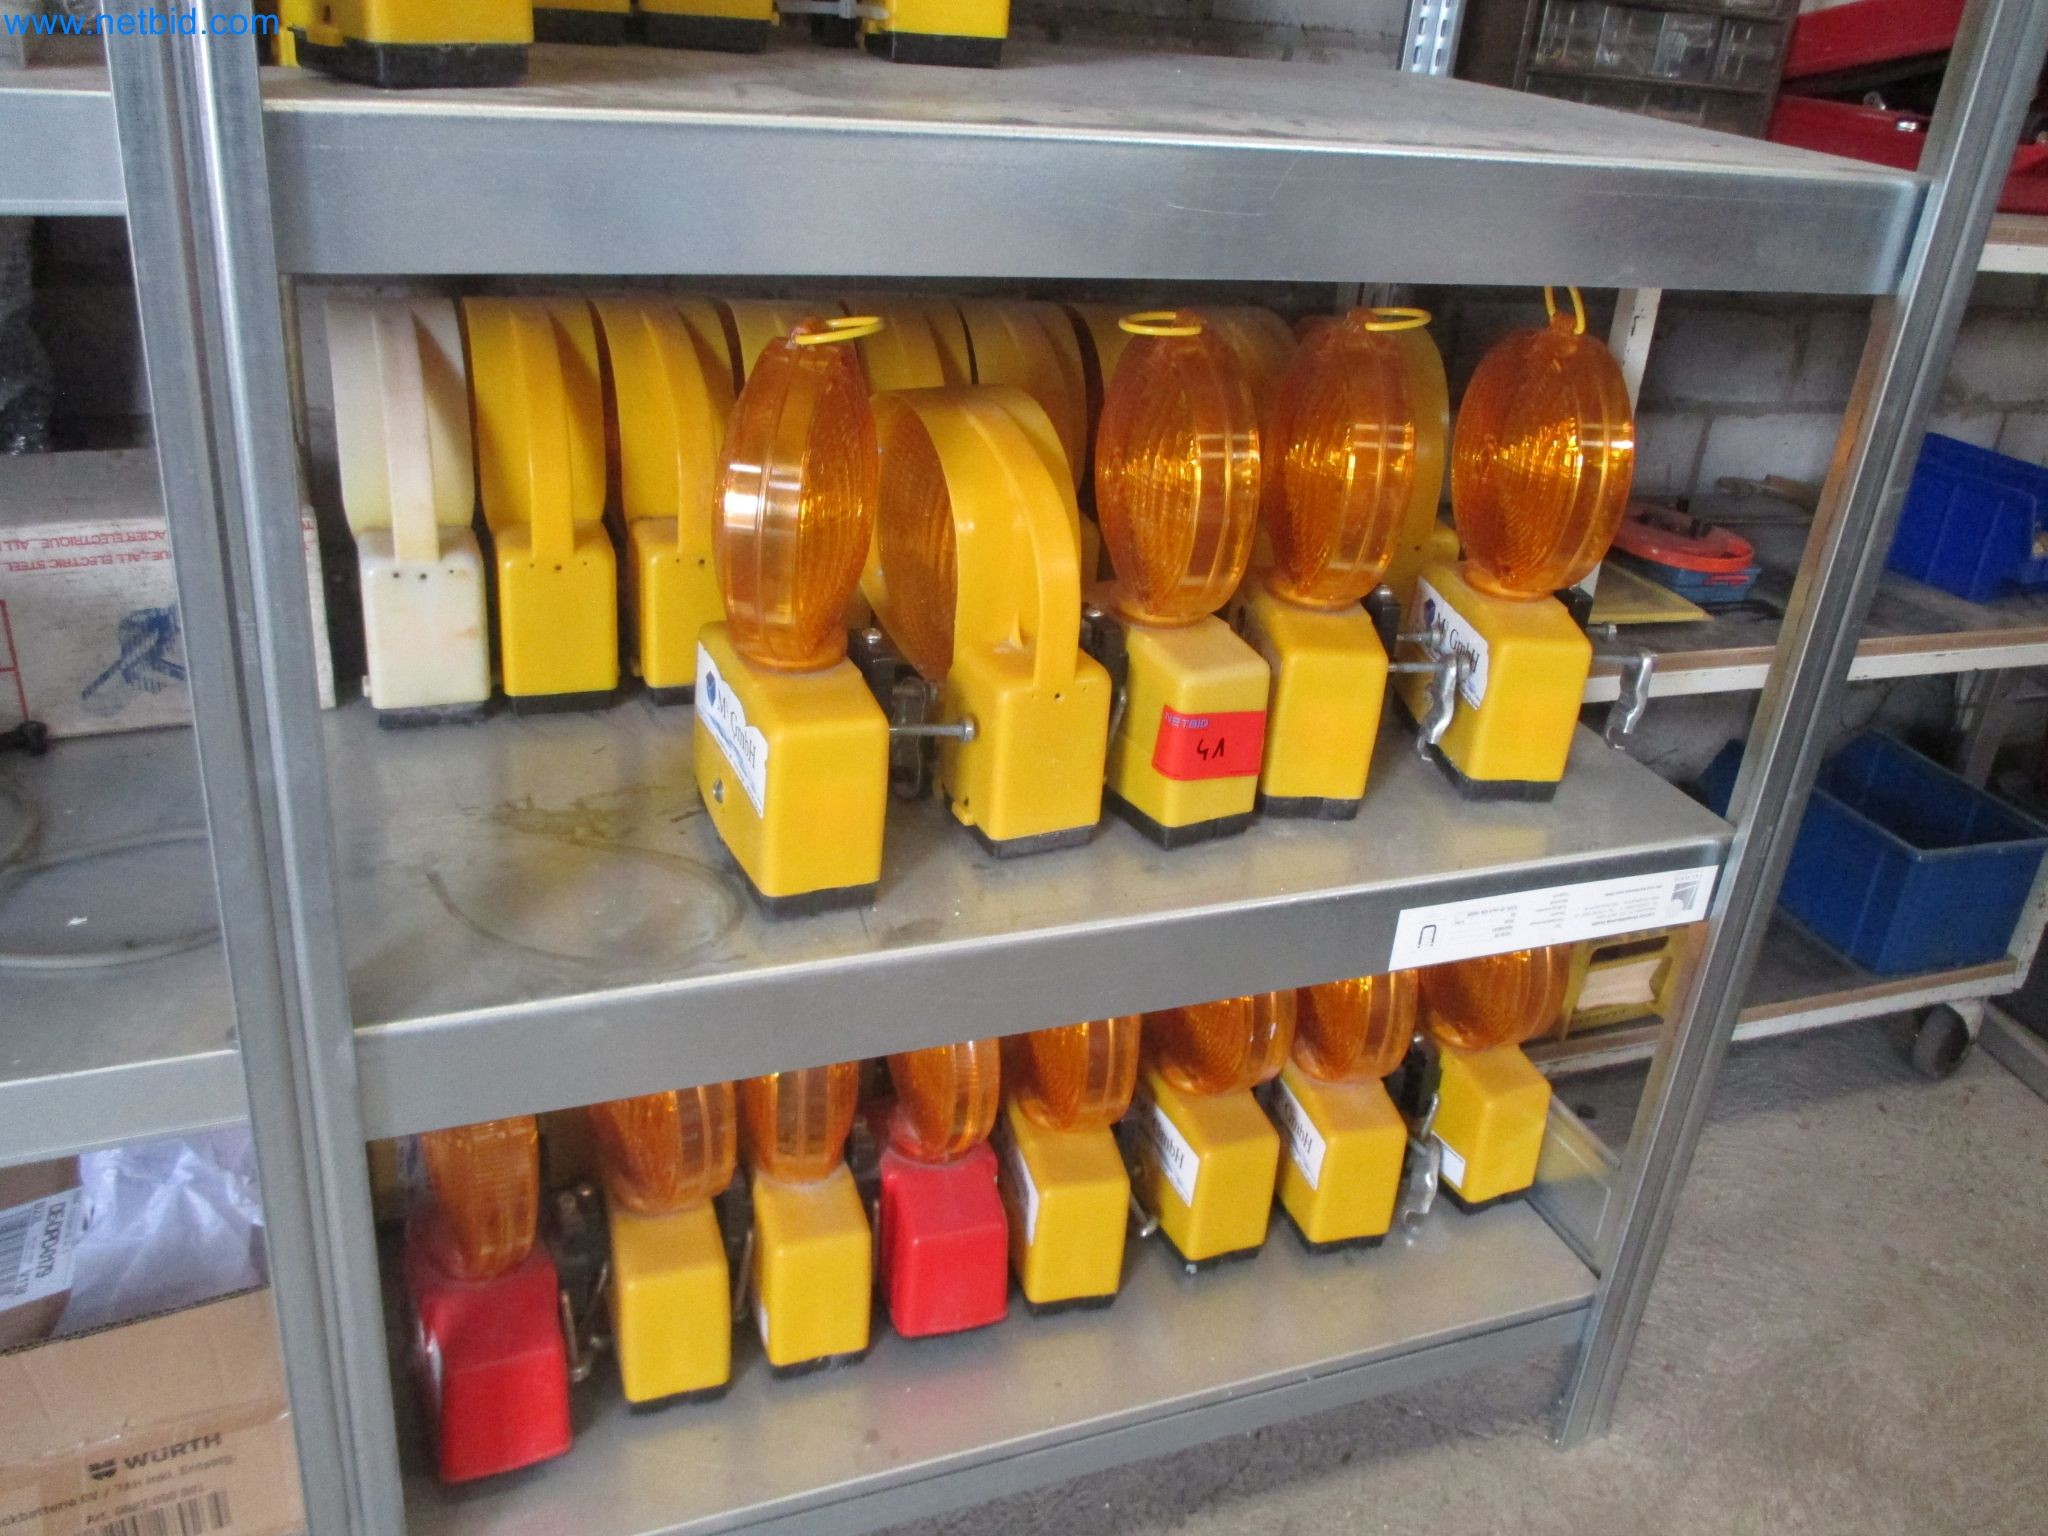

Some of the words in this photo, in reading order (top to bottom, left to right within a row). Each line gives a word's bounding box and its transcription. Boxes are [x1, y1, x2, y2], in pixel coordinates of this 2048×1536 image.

[126, 530, 166, 544] ACIER
[48, 554, 113, 570] ELECTRIC
[1165, 711, 1210, 729] NETBID
[730, 711, 757, 769] GmbH
[1196, 737, 1225, 761] 41
[124, 1432, 223, 1470] WÜRTH
